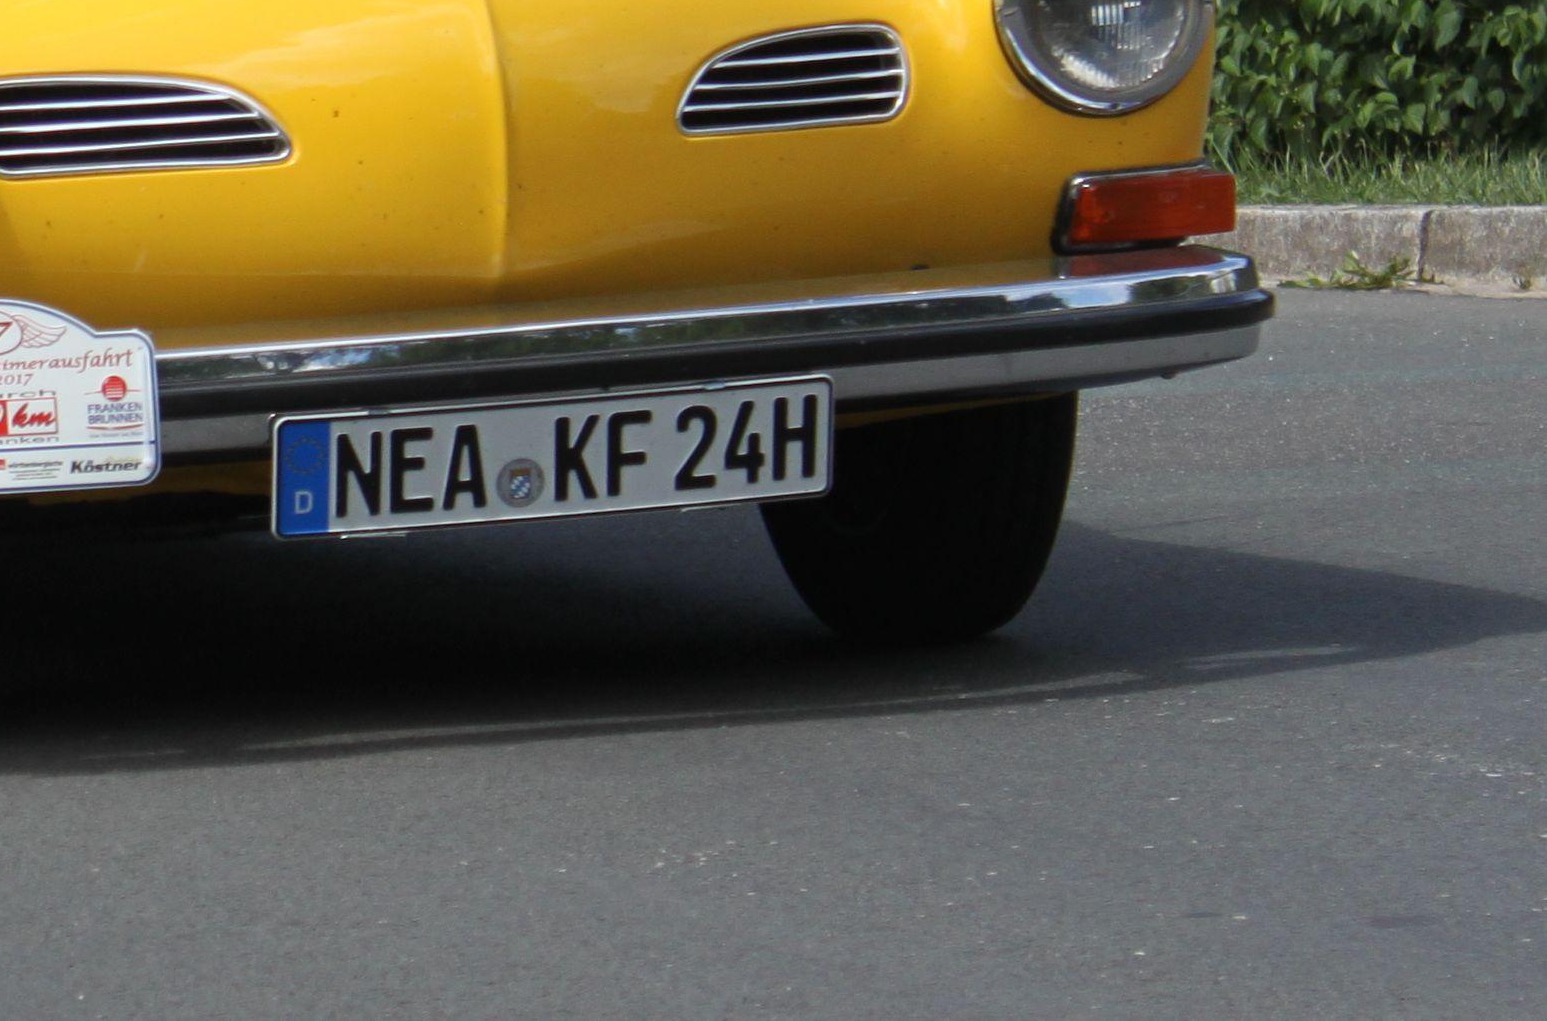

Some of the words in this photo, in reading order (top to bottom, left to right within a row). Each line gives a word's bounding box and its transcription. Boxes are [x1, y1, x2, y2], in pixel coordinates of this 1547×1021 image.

[12, 403, 55, 428] km
[87, 402, 142, 414] FRANKEN
[88, 413, 142, 424] BRUNNEN
[336, 424, 486, 518] NEA
[554, 409, 652, 501] KF
[675, 394, 818, 491] 24H
[70, 460, 143, 474] Köstner
[295, 489, 314, 514] D
